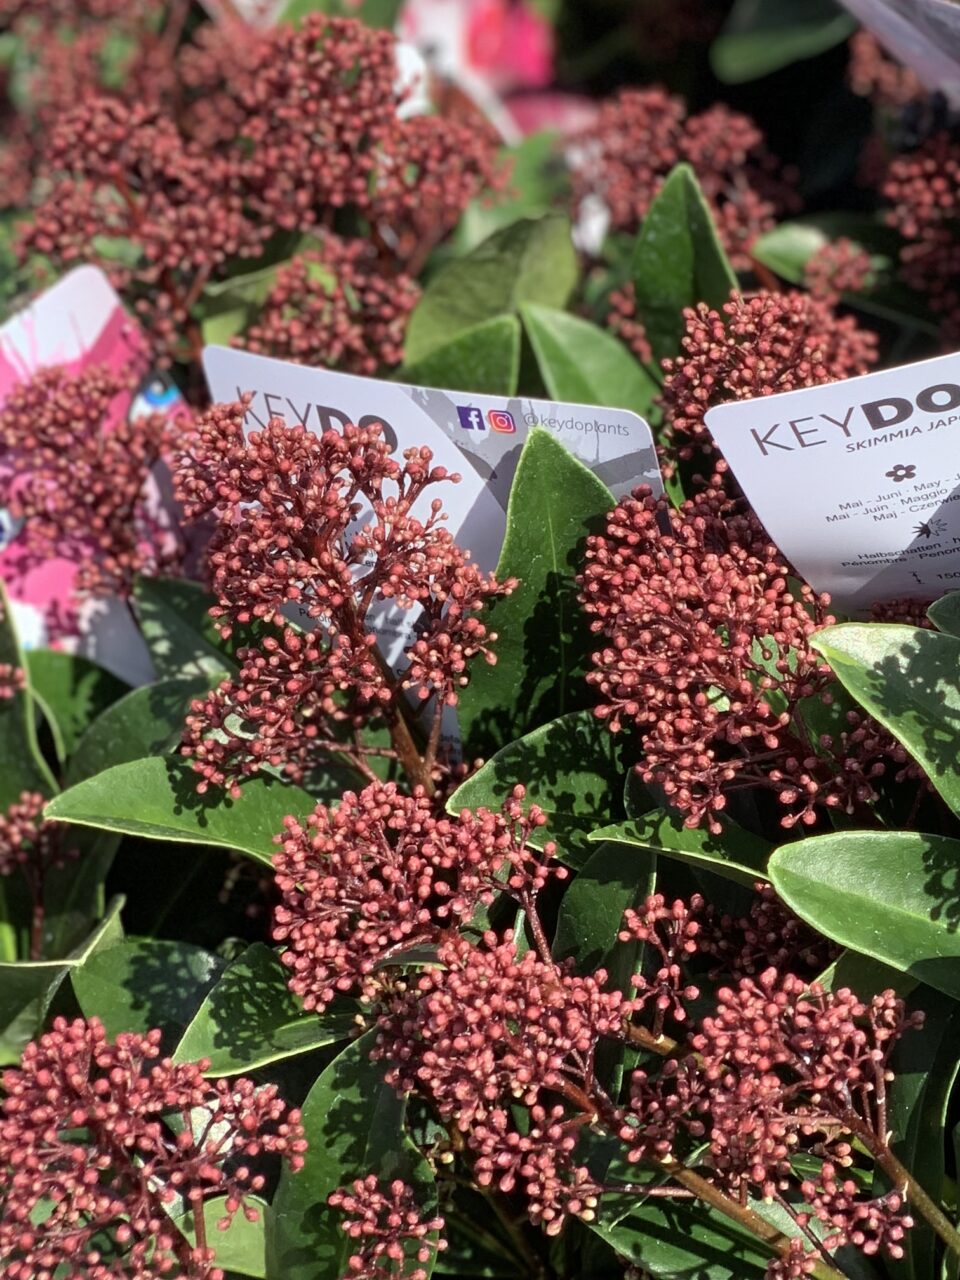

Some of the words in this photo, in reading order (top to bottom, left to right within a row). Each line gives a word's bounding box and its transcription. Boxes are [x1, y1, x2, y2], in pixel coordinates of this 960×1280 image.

[524, 412, 630, 436] @keydoplants
[846, 426, 922, 453] SKIMMIA
[825, 513, 850, 523] Mai
[863, 504, 889, 515] Juin
[901, 488, 948, 505] Maggio
[838, 500, 863, 511] Mai
[875, 490, 902, 502] Juni
[913, 480, 941, 492] May
[873, 511, 898, 522] Maj
[858, 542, 942, 560] Halbschatten
